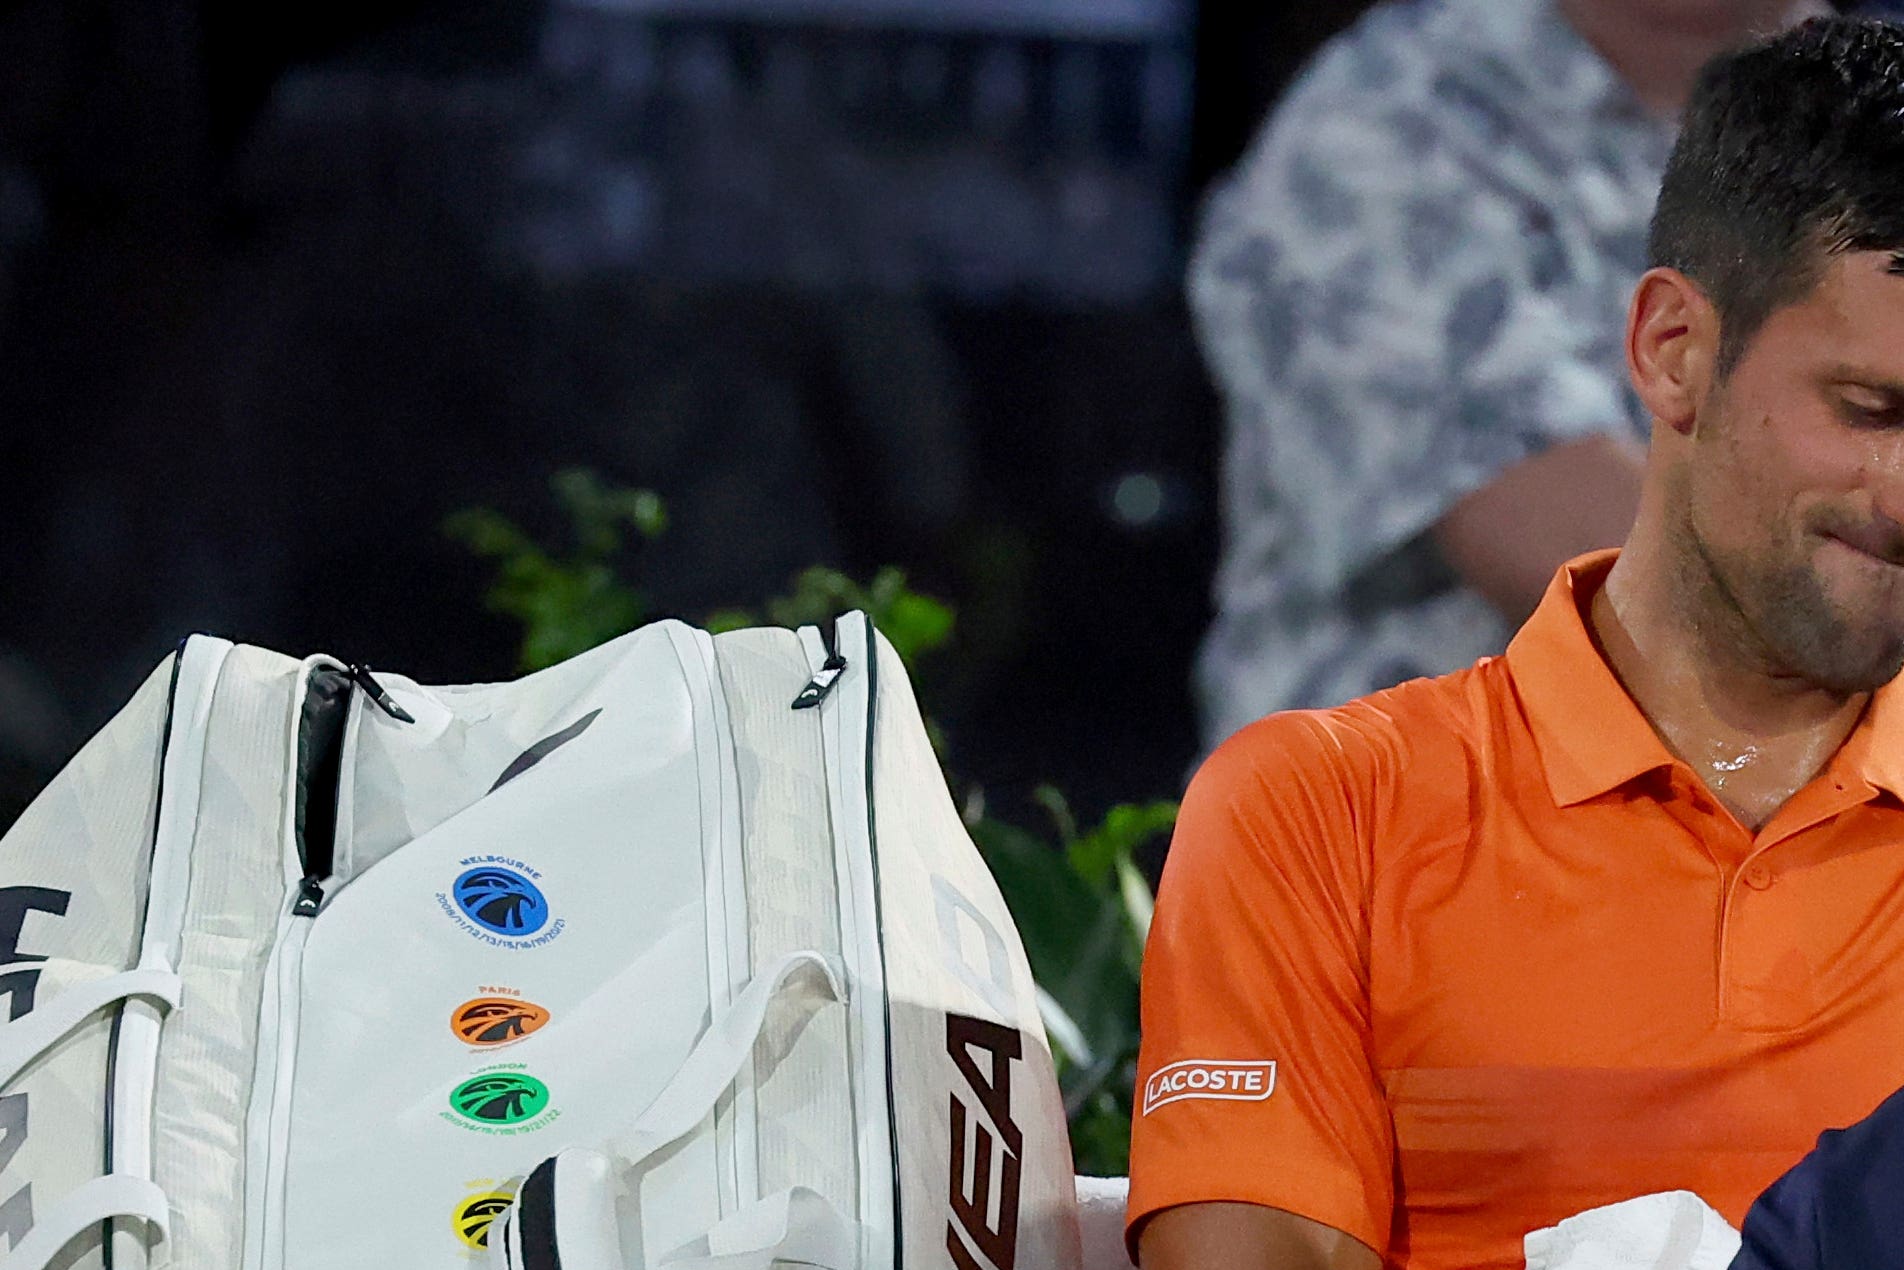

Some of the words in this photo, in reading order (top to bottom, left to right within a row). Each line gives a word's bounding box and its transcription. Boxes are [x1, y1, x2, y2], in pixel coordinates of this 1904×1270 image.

[459, 855, 542, 880] MELBOURNE
[478, 986, 521, 996] PARIS
[1148, 1068, 1263, 1103] LACOSTE
